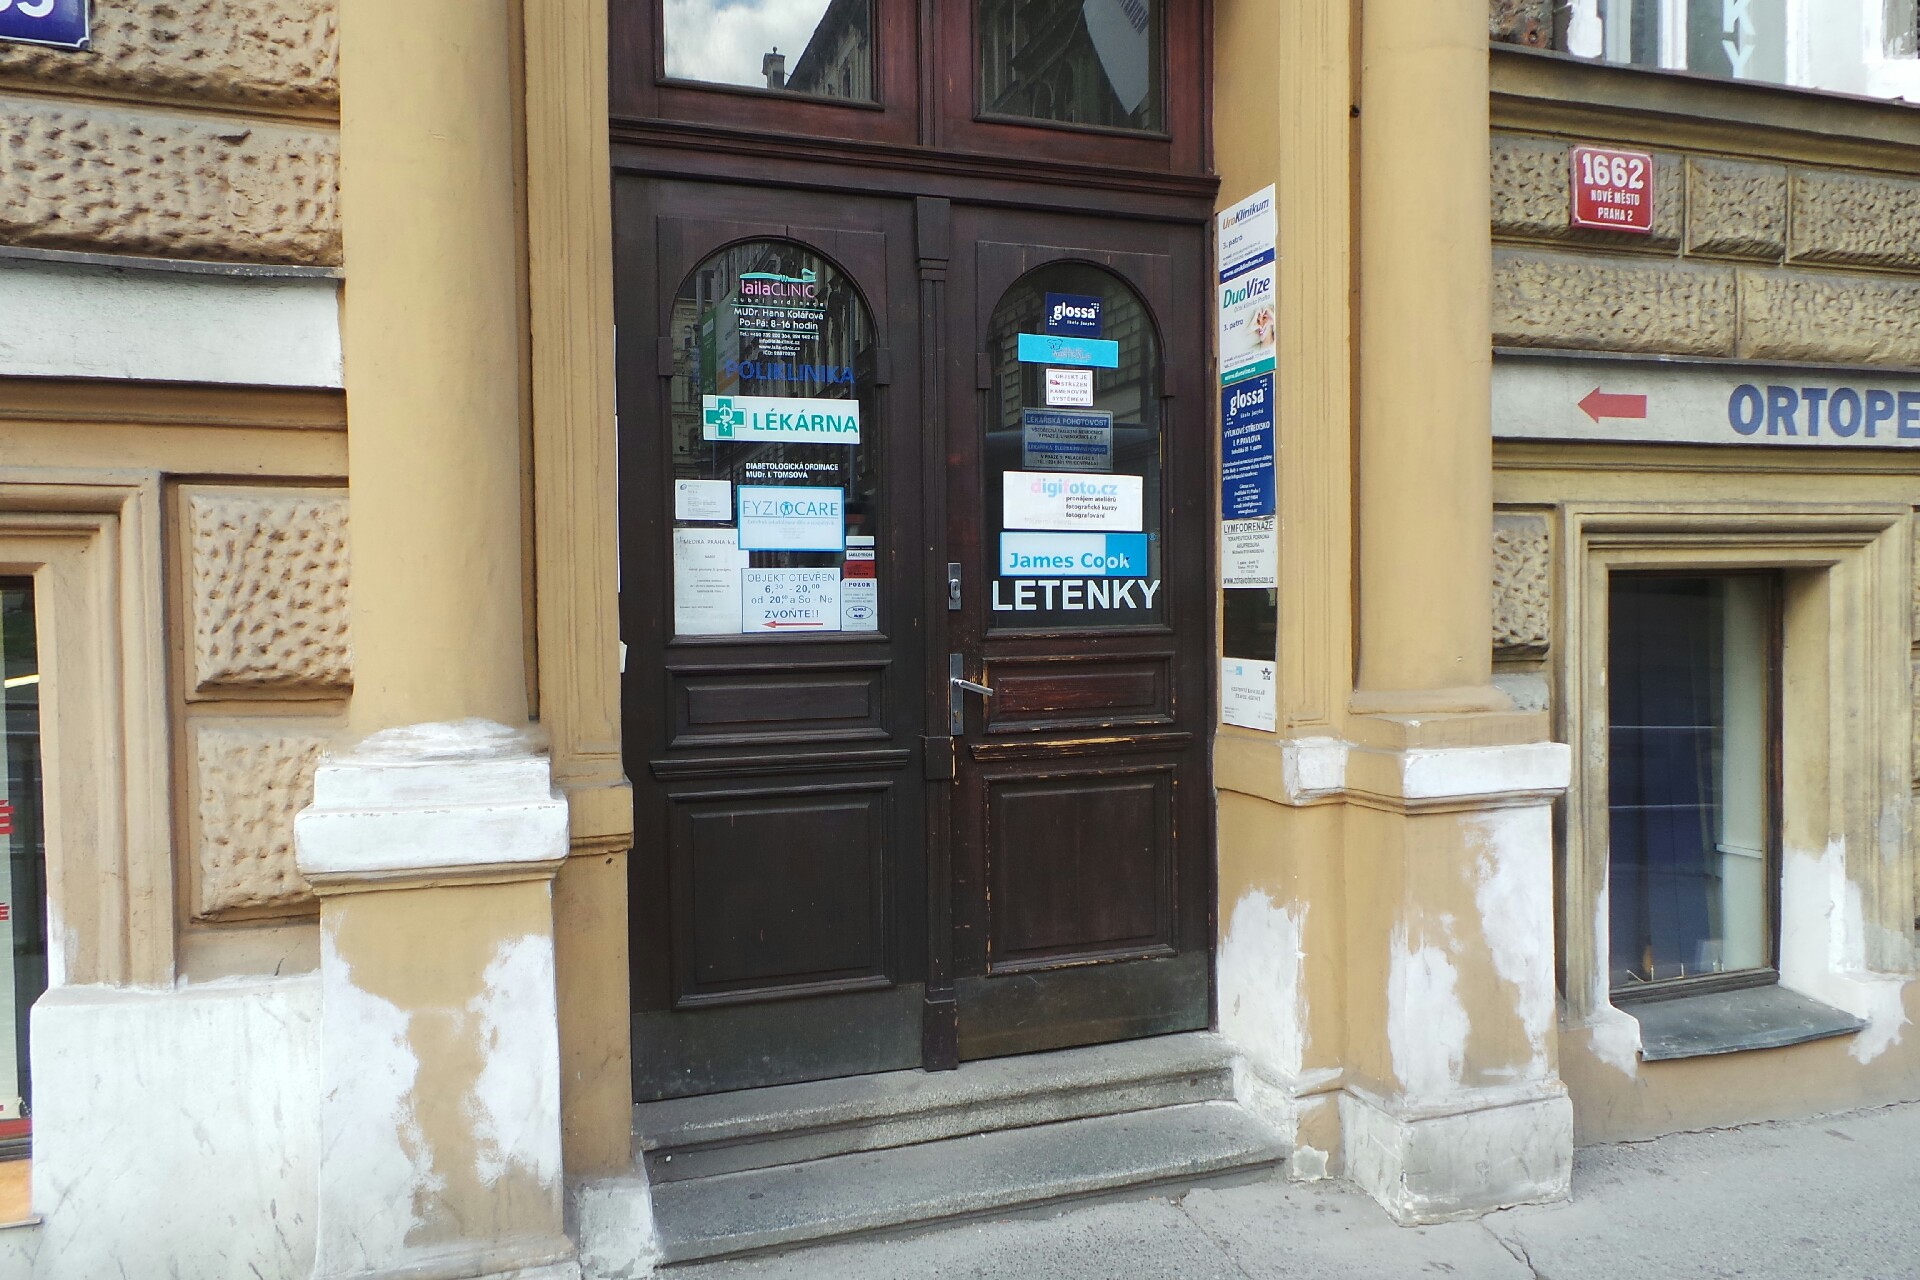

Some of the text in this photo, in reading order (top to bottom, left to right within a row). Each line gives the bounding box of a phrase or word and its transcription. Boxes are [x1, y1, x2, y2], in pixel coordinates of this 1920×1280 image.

[1583, 153, 1644, 189] 1662
[1591, 188, 1640, 206] NOVÉ MĚSTO
[1223, 199, 1269, 230] UroKlinikum
[1598, 207, 1633, 221] PRAHA 2
[1228, 235, 1243, 248] patro
[741, 280, 816, 298] lailaCLINIC
[1223, 277, 1271, 308] DuoVize
[734, 308, 824, 320] MUDr. Hana Kolářová
[1053, 302, 1096, 320] glossa
[793, 321, 818, 330] hodin
[1229, 319, 1244, 330] patro
[724, 360, 855, 384] POLIKLINIKA
[1230, 388, 1264, 416] glossa
[1728, 383, 1920, 438] ORTOPE
[753, 408, 859, 433] LÉKÁRNA
[1062, 418, 1107, 426] POHOTOVOST
[746, 461, 839, 471] DIABETOLOGICKÁ ORDINACE
[773, 470, 808, 479] TOMSOVÁ
[1031, 478, 1118, 498] digifoto.cz
[1065, 503, 1100, 511] fotografické
[1009, 553, 1130, 569] James Cook
[747, 572, 835, 582] OBJEKT OTEVŘEN
[751, 596, 764, 604] od
[798, 595, 811, 604] So
[819, 595, 833, 603] Ne
[992, 579, 1161, 611] LETENKY
